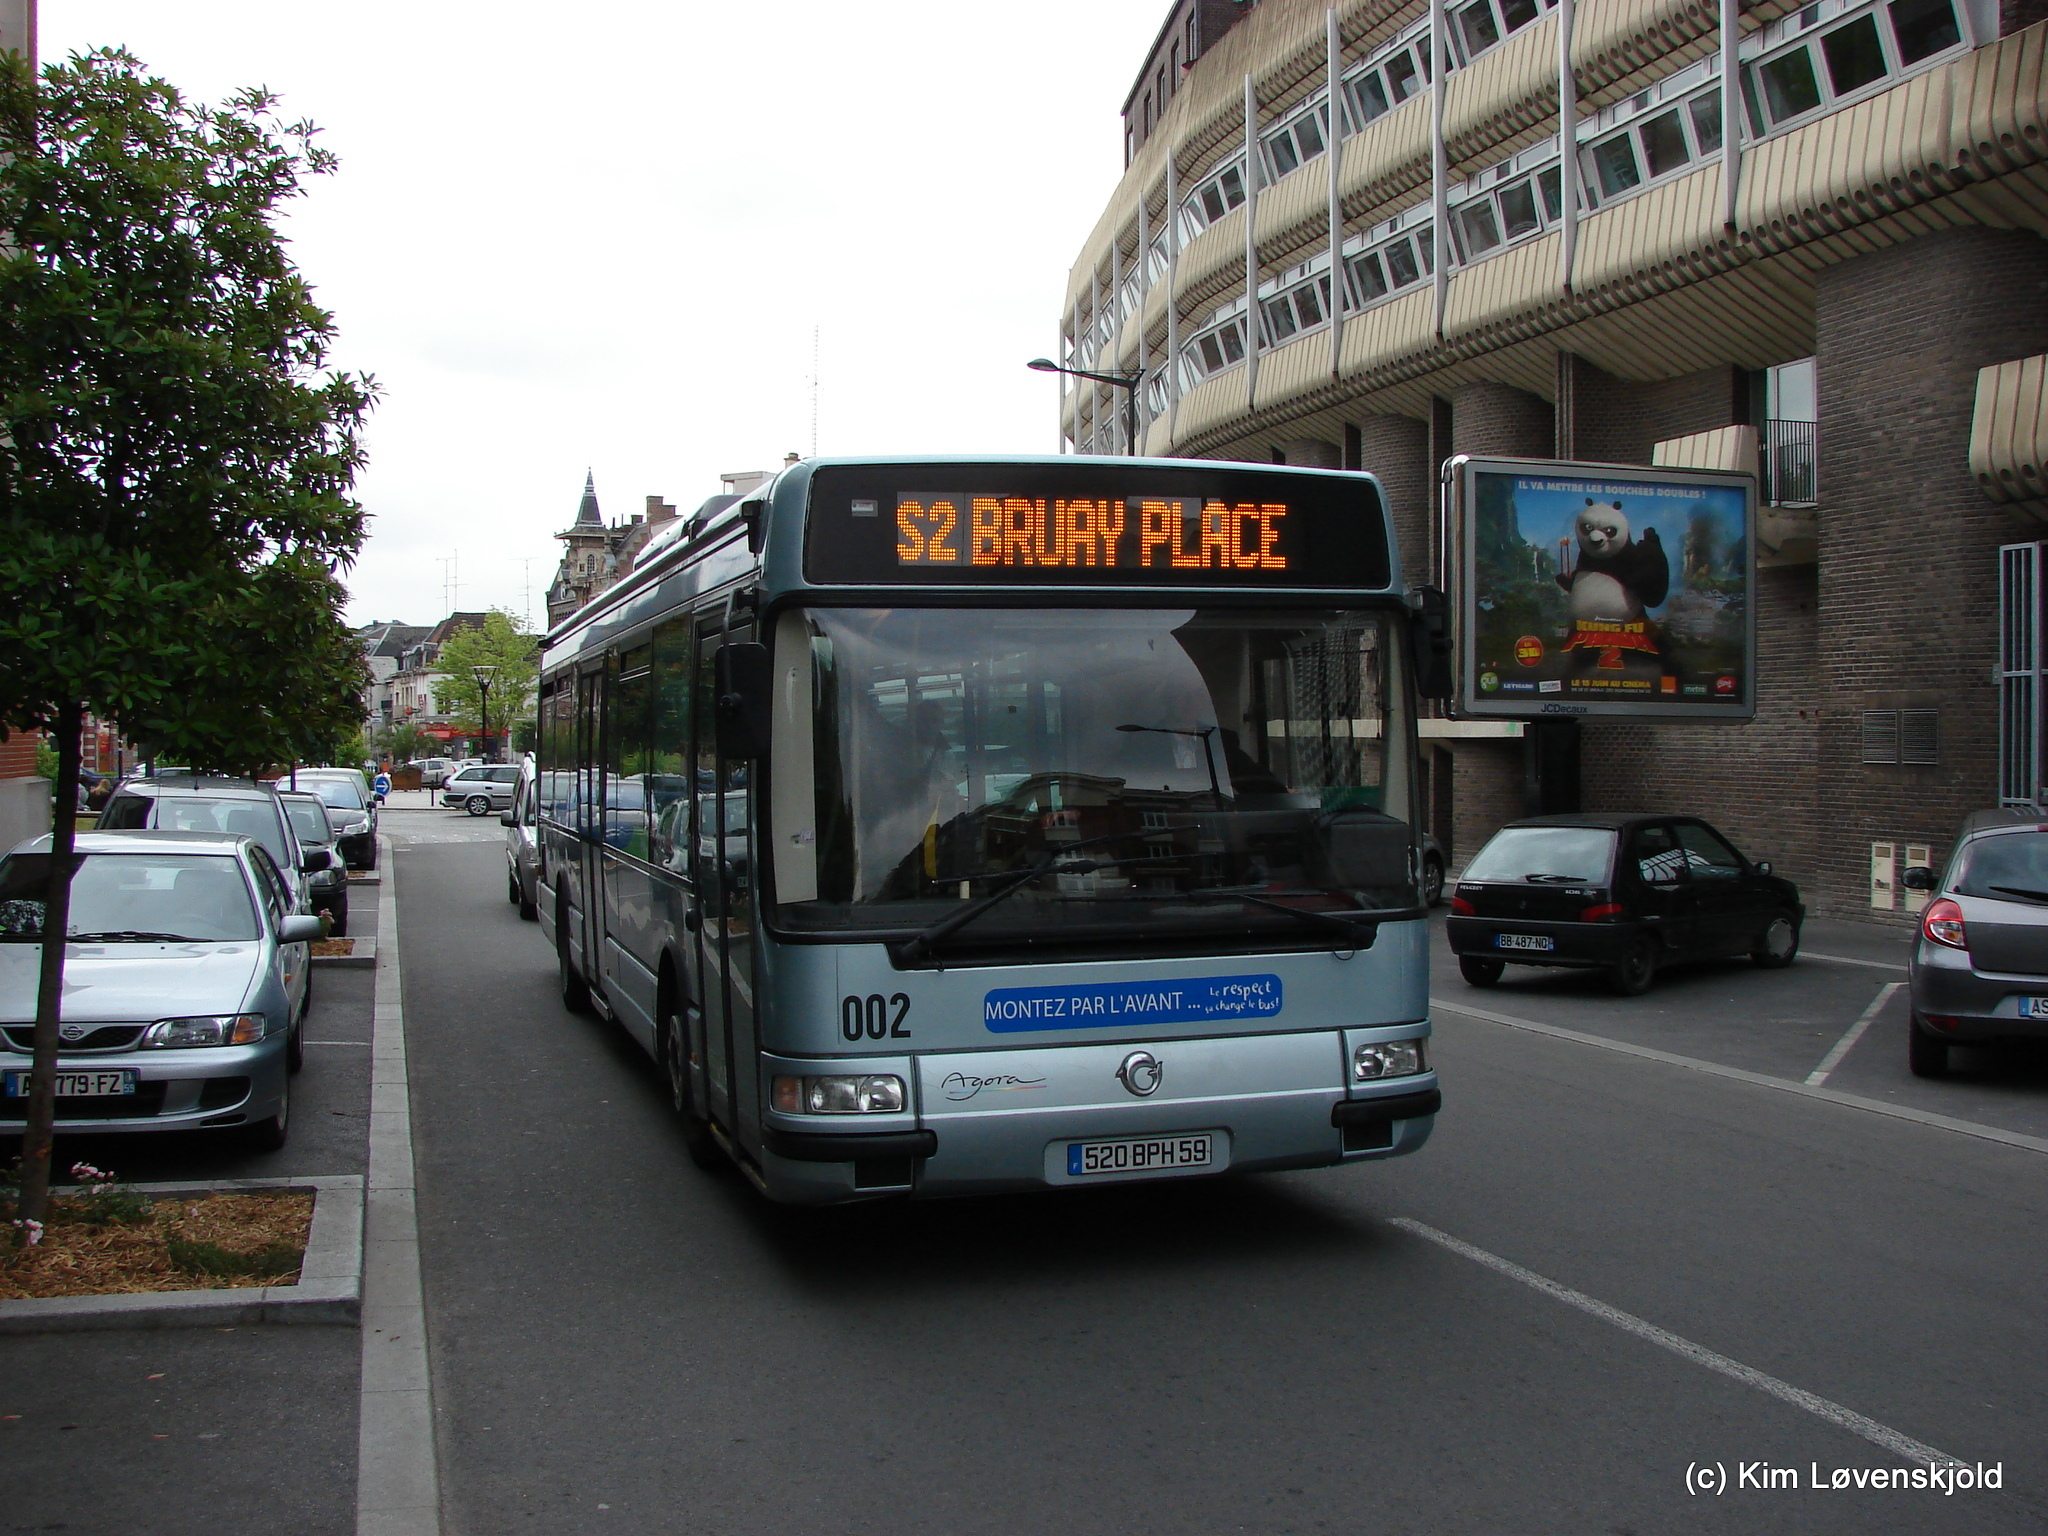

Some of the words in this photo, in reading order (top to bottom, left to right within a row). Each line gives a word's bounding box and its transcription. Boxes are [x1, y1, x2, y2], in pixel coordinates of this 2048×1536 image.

[1518, 481, 1528, 489] IL
[1531, 481, 1544, 490] VA
[1547, 482, 1583, 492] METTRE
[1586, 484, 1602, 493] LES
[1656, 487, 1700, 498] DOUBLES
[896, 500, 957, 562] S2
[971, 497, 1126, 567] BRUAY
[1140, 500, 1287, 569] PLACE
[1576, 620, 1622, 633] KUNG
[1624, 622, 1644, 633] FU
[1518, 647, 1540, 658] 3D
[1597, 647, 1625, 670] 2
[1571, 679, 1580, 687] LE
[1610, 680, 1621, 688] AU
[1541, 703, 1588, 713] JCDecaux
[1223, 981, 1271, 1001] respect
[986, 998, 1066, 1020] MONTEZ
[1071, 996, 1105, 1016] PAR
[1110, 991, 1183, 1014] L'AVANT
[1215, 1000, 1246, 1014] change
[1258, 997, 1279, 1010] bus!
[842, 992, 911, 1041] 002
[22, 1074, 120, 1095] A779-FZ
[941, 1072, 1047, 1101] Agora
[1085, 1145, 1128, 1169] 520
[1132, 1142, 1174, 1166] BPH
[1179, 1139, 1207, 1163] 59
[1073, 1162, 1079, 1170] F
